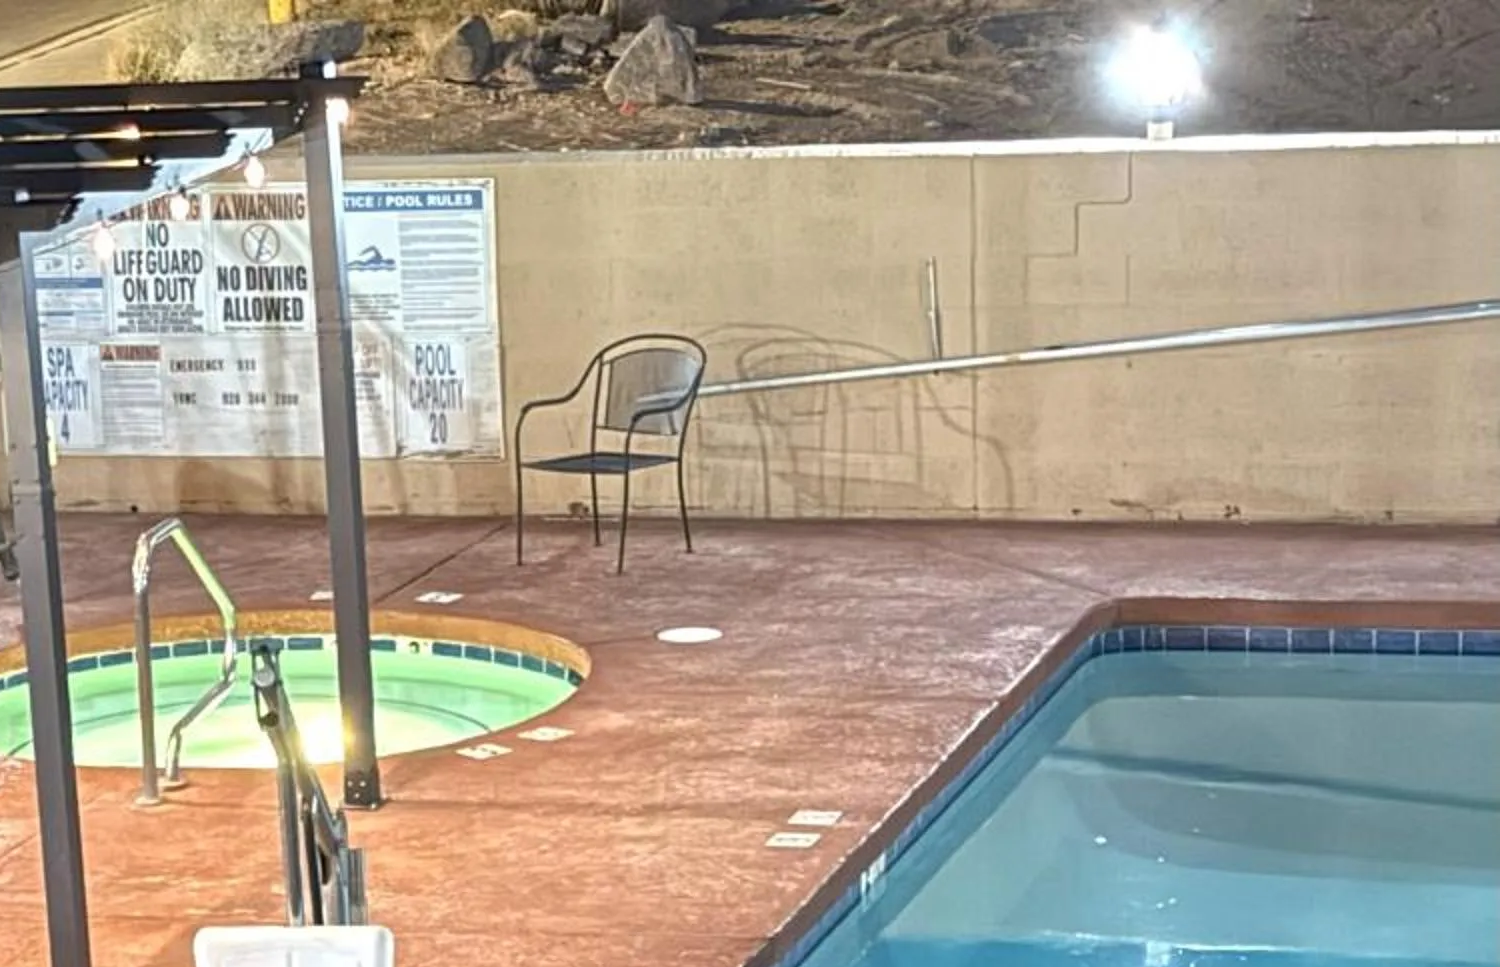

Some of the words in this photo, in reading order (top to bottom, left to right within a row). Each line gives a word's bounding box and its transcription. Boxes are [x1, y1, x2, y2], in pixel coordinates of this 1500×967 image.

[234, 193, 305, 220] WARNING
[344, 195, 374, 208] TICE
[385, 194, 424, 207] POOL
[427, 193, 472, 206] RULES
[146, 223, 169, 247] NO
[123, 277, 148, 302] ON
[154, 277, 197, 302] DUTY
[217, 266, 240, 291] NO
[246, 265, 308, 291] DIVING
[223, 296, 304, 322] ALLOWED
[47, 347, 75, 377] SPA
[170, 359, 224, 373] EMERGENCY
[415, 344, 456, 376] POOL
[44, 379, 88, 411] APACITY
[409, 378, 464, 411] CAPACITY
[61, 413, 70, 444] 4
[429, 412, 448, 444] 20
